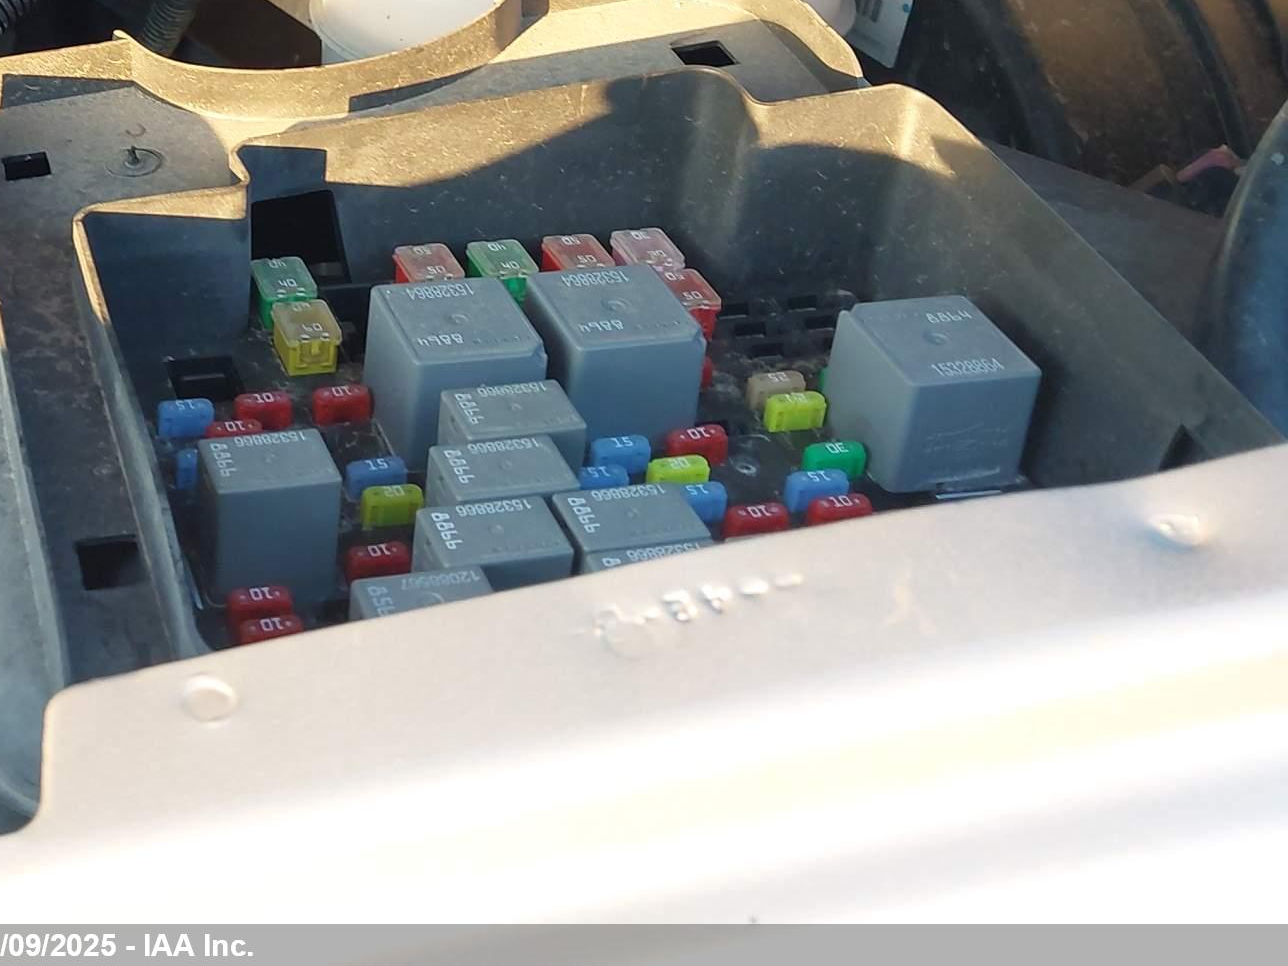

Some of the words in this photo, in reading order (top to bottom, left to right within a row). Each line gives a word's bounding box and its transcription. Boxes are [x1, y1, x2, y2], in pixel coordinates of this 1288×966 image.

[487, 241, 506, 251] 40
[500, 260, 520, 270] 40
[279, 278, 298, 289] 40
[405, 283, 476, 301] 15328864
[682, 290, 703, 301] 50
[925, 310, 972, 324] 8864
[578, 320, 625, 333] 8864
[416, 333, 465, 347] 8864
[930, 357, 1006, 378] 15328864
[254, 392, 275, 403] 10
[331, 385, 353, 397] 10
[175, 399, 196, 411] 15
[454, 393, 485, 425] 8866
[225, 420, 247, 432] 10
[234, 431, 308, 448] 15328866
[686, 426, 711, 441] 10
[611, 436, 634, 448] 15
[824, 442, 850, 454] 30
[210, 442, 238, 477] 8866
[366, 458, 389, 471] 15
[668, 458, 691, 469] 20
[443, 449, 476, 484] 8866
[587, 465, 611, 478] 15
[807, 471, 831, 482] 15
[384, 485, 406, 497] 20
[591, 484, 667, 502] 15328866
[685, 484, 710, 496] 15
[456, 498, 532, 517] 15328866
[829, 495, 853, 507] 10
[567, 497, 601, 534] 8866
[747, 504, 774, 518] 10
[431, 512, 464, 550] 8866
[368, 543, 392, 557] 10
[249, 587, 274, 601] 10
[260, 617, 284, 632] 10
